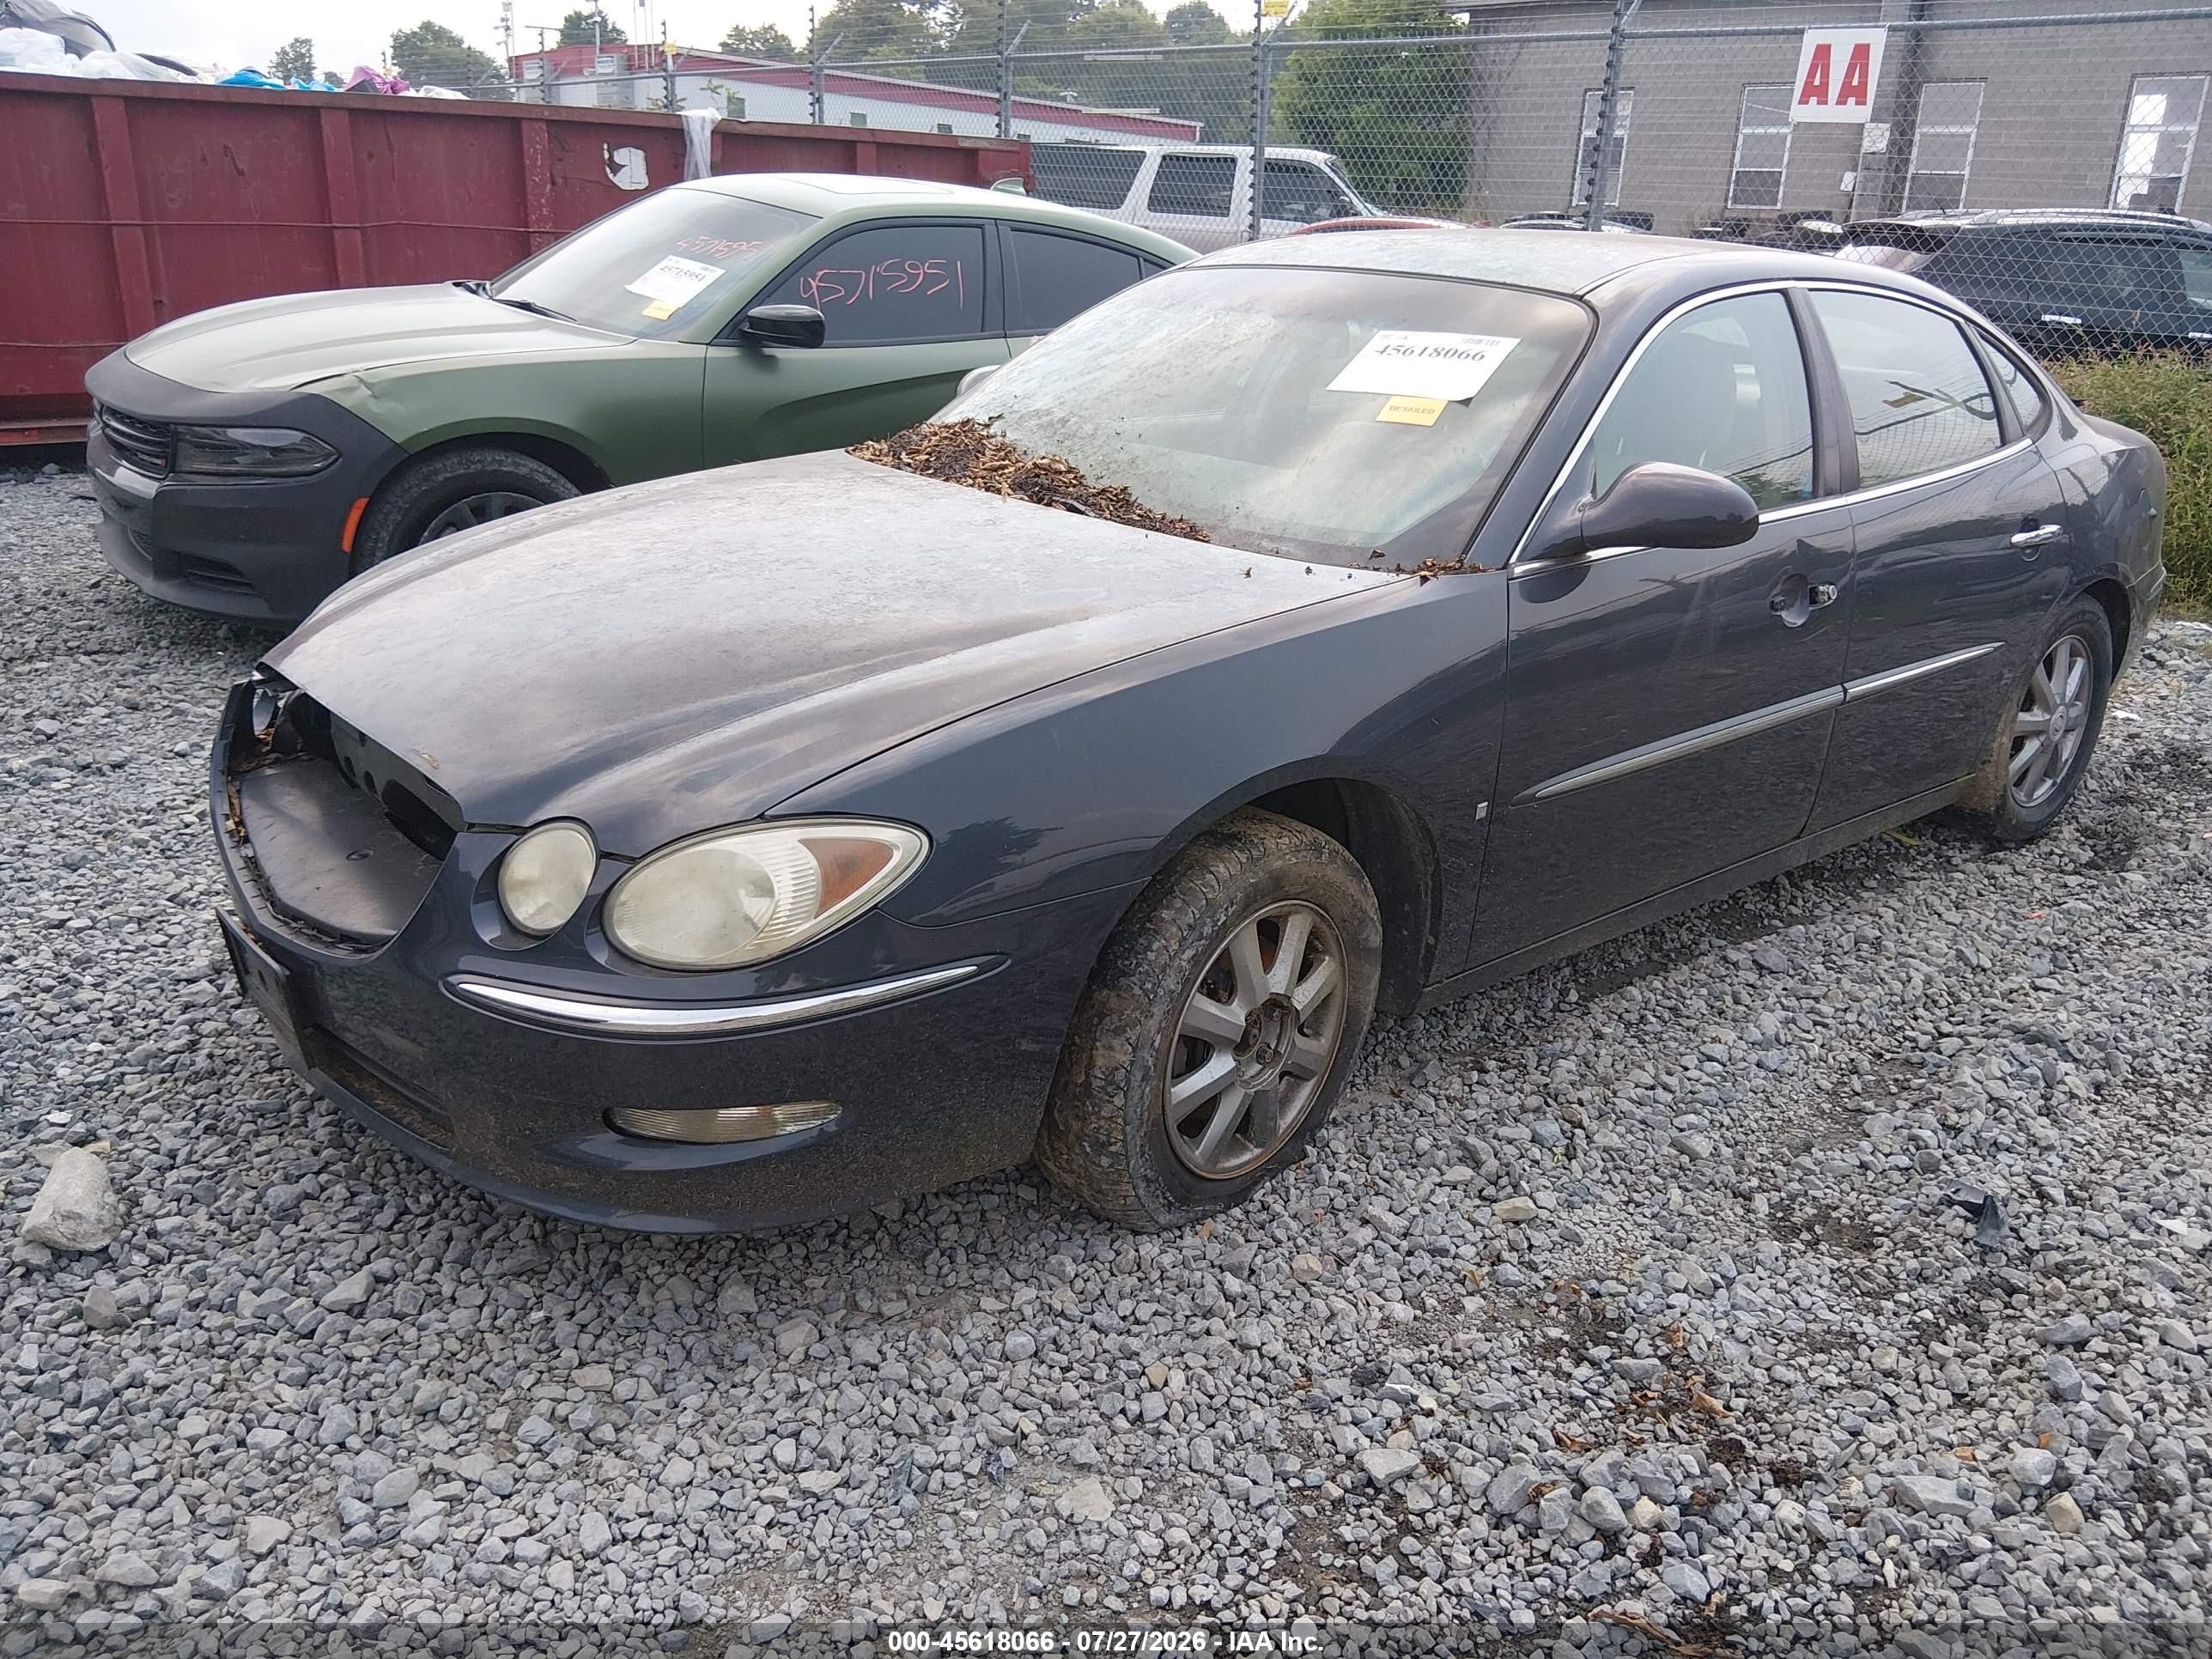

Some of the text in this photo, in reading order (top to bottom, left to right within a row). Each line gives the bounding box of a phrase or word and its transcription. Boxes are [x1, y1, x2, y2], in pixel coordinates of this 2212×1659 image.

[1797, 43, 1871, 106] AA
[659, 264, 706, 283] 45715951
[799, 258, 964, 311] 45715951
[1375, 343, 1488, 362] 45618066
[1389, 405, 1435, 415] DETAILED
